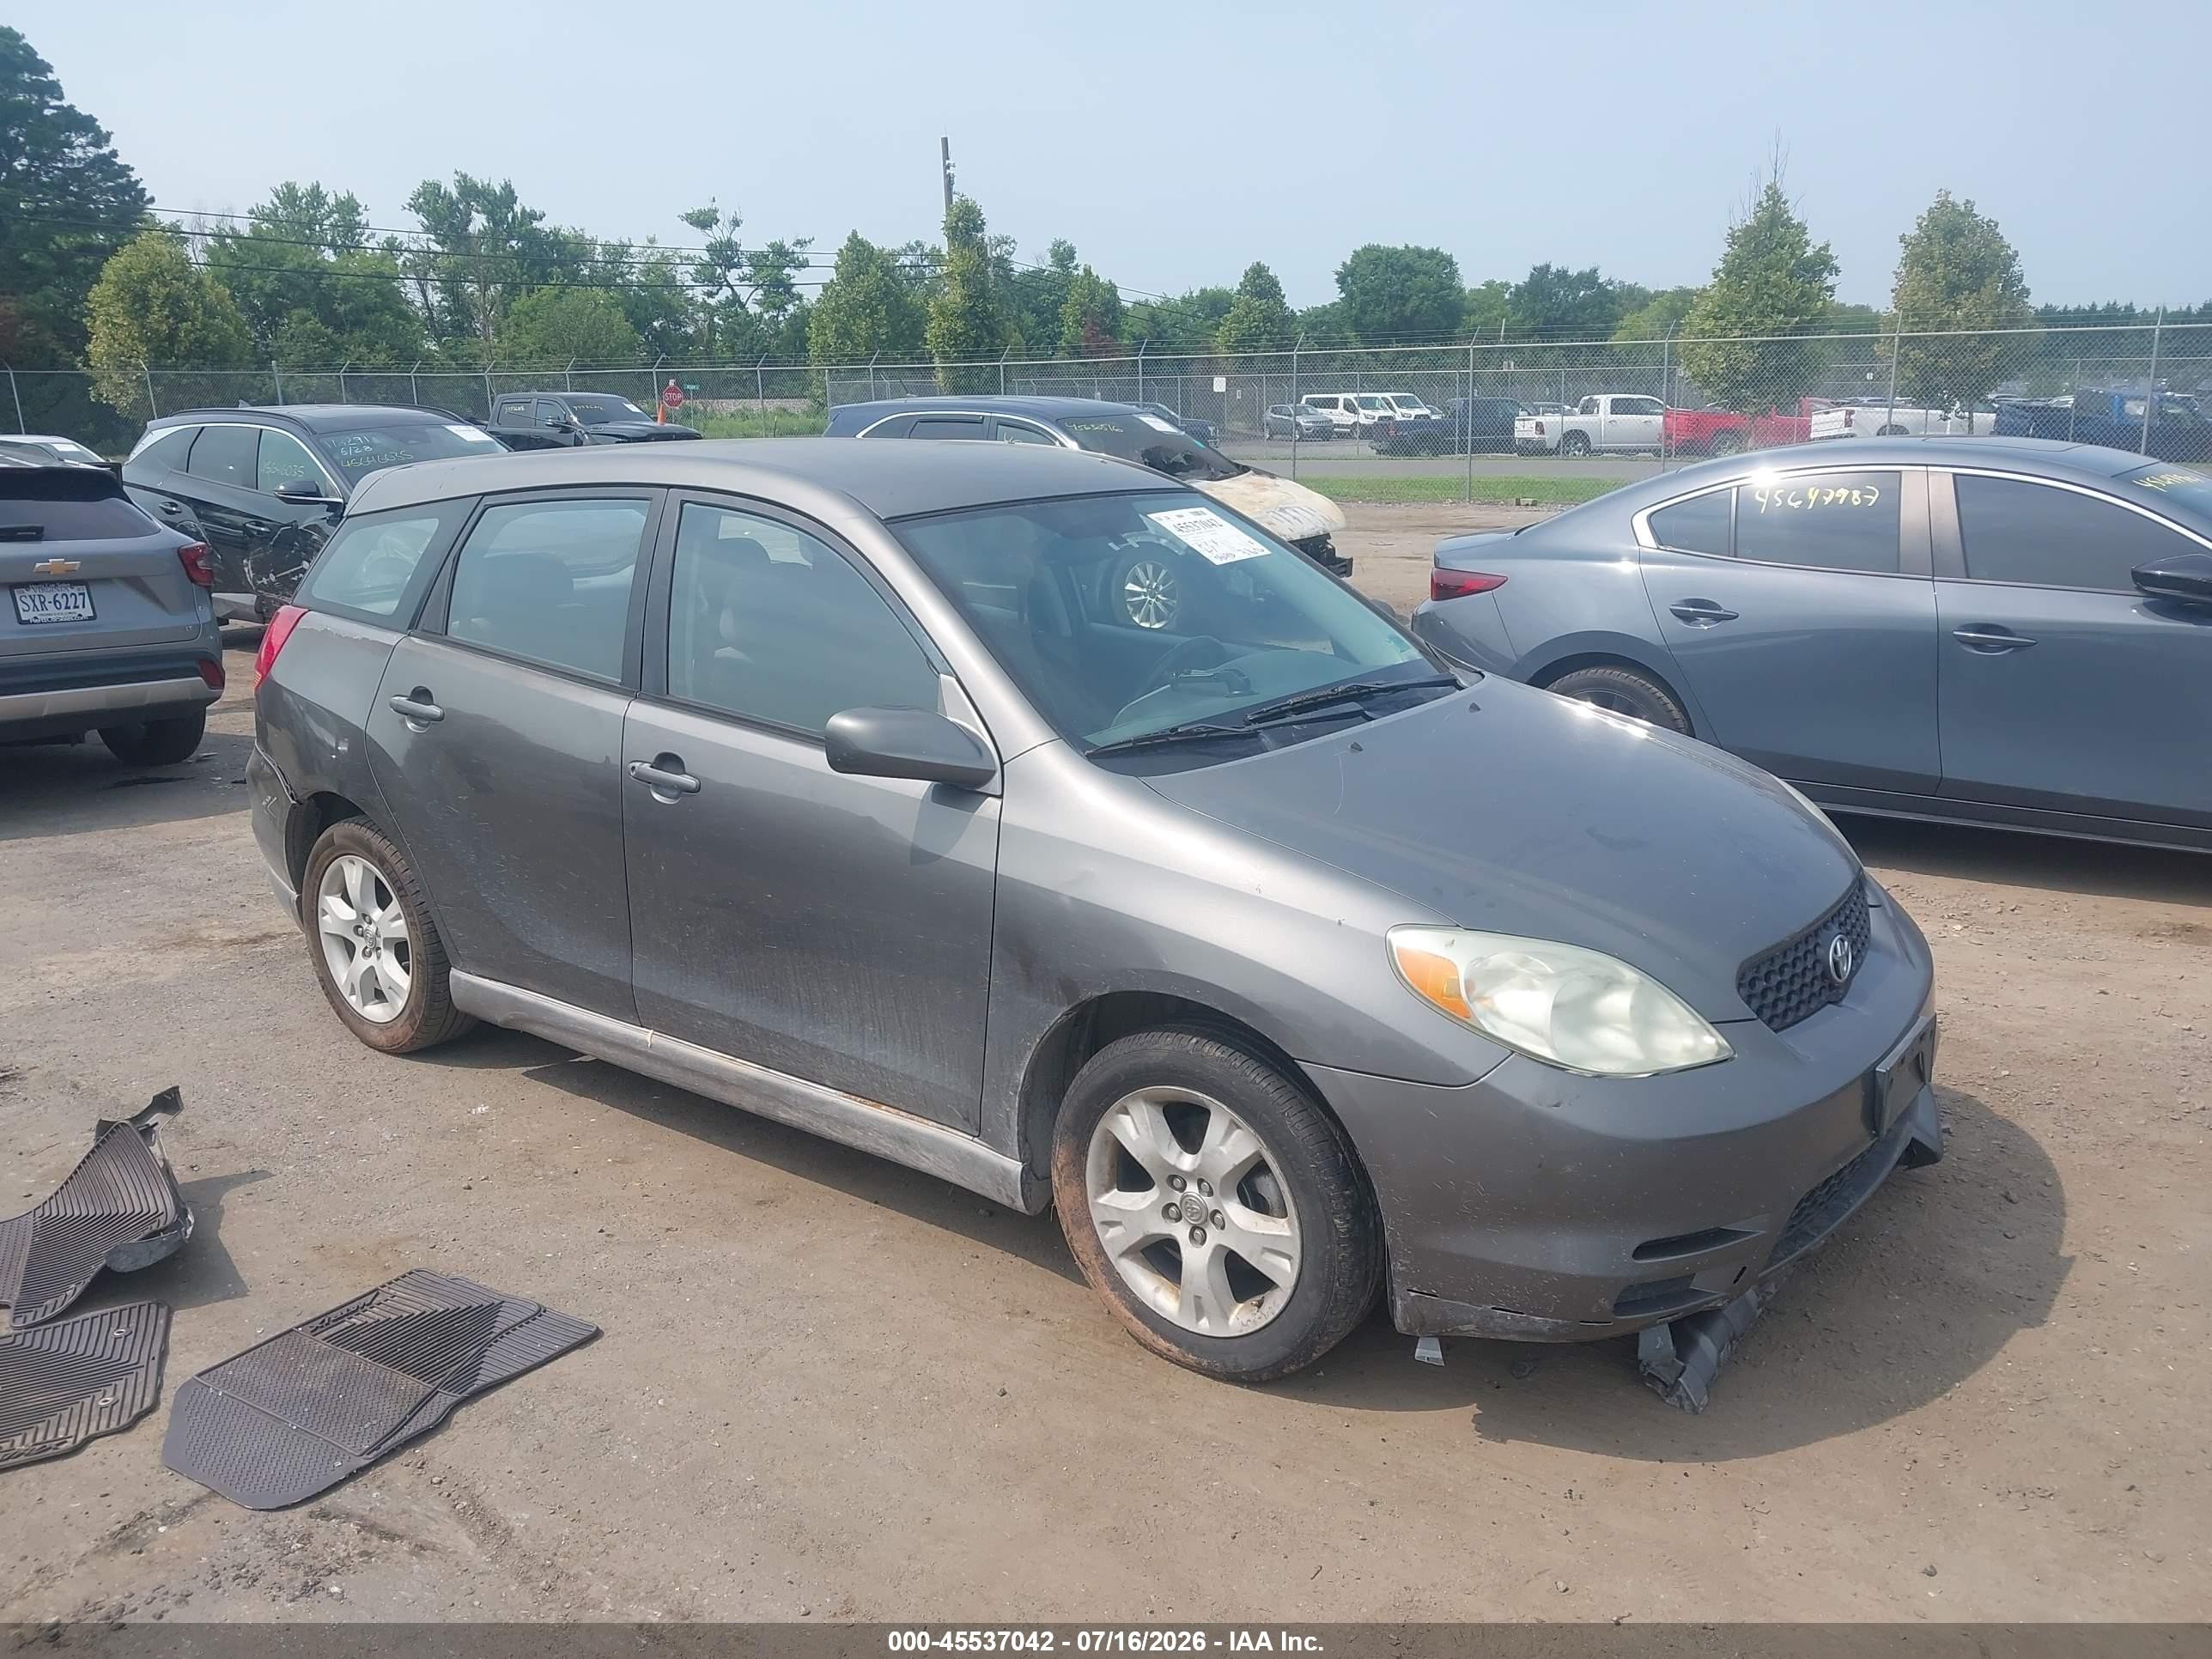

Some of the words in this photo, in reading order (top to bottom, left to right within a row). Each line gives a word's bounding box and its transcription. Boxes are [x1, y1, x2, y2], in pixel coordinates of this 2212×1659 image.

[665, 392, 682, 401] STOP
[1755, 485, 1880, 514] 45647987
[19, 592, 86, 612] SXR-6227
